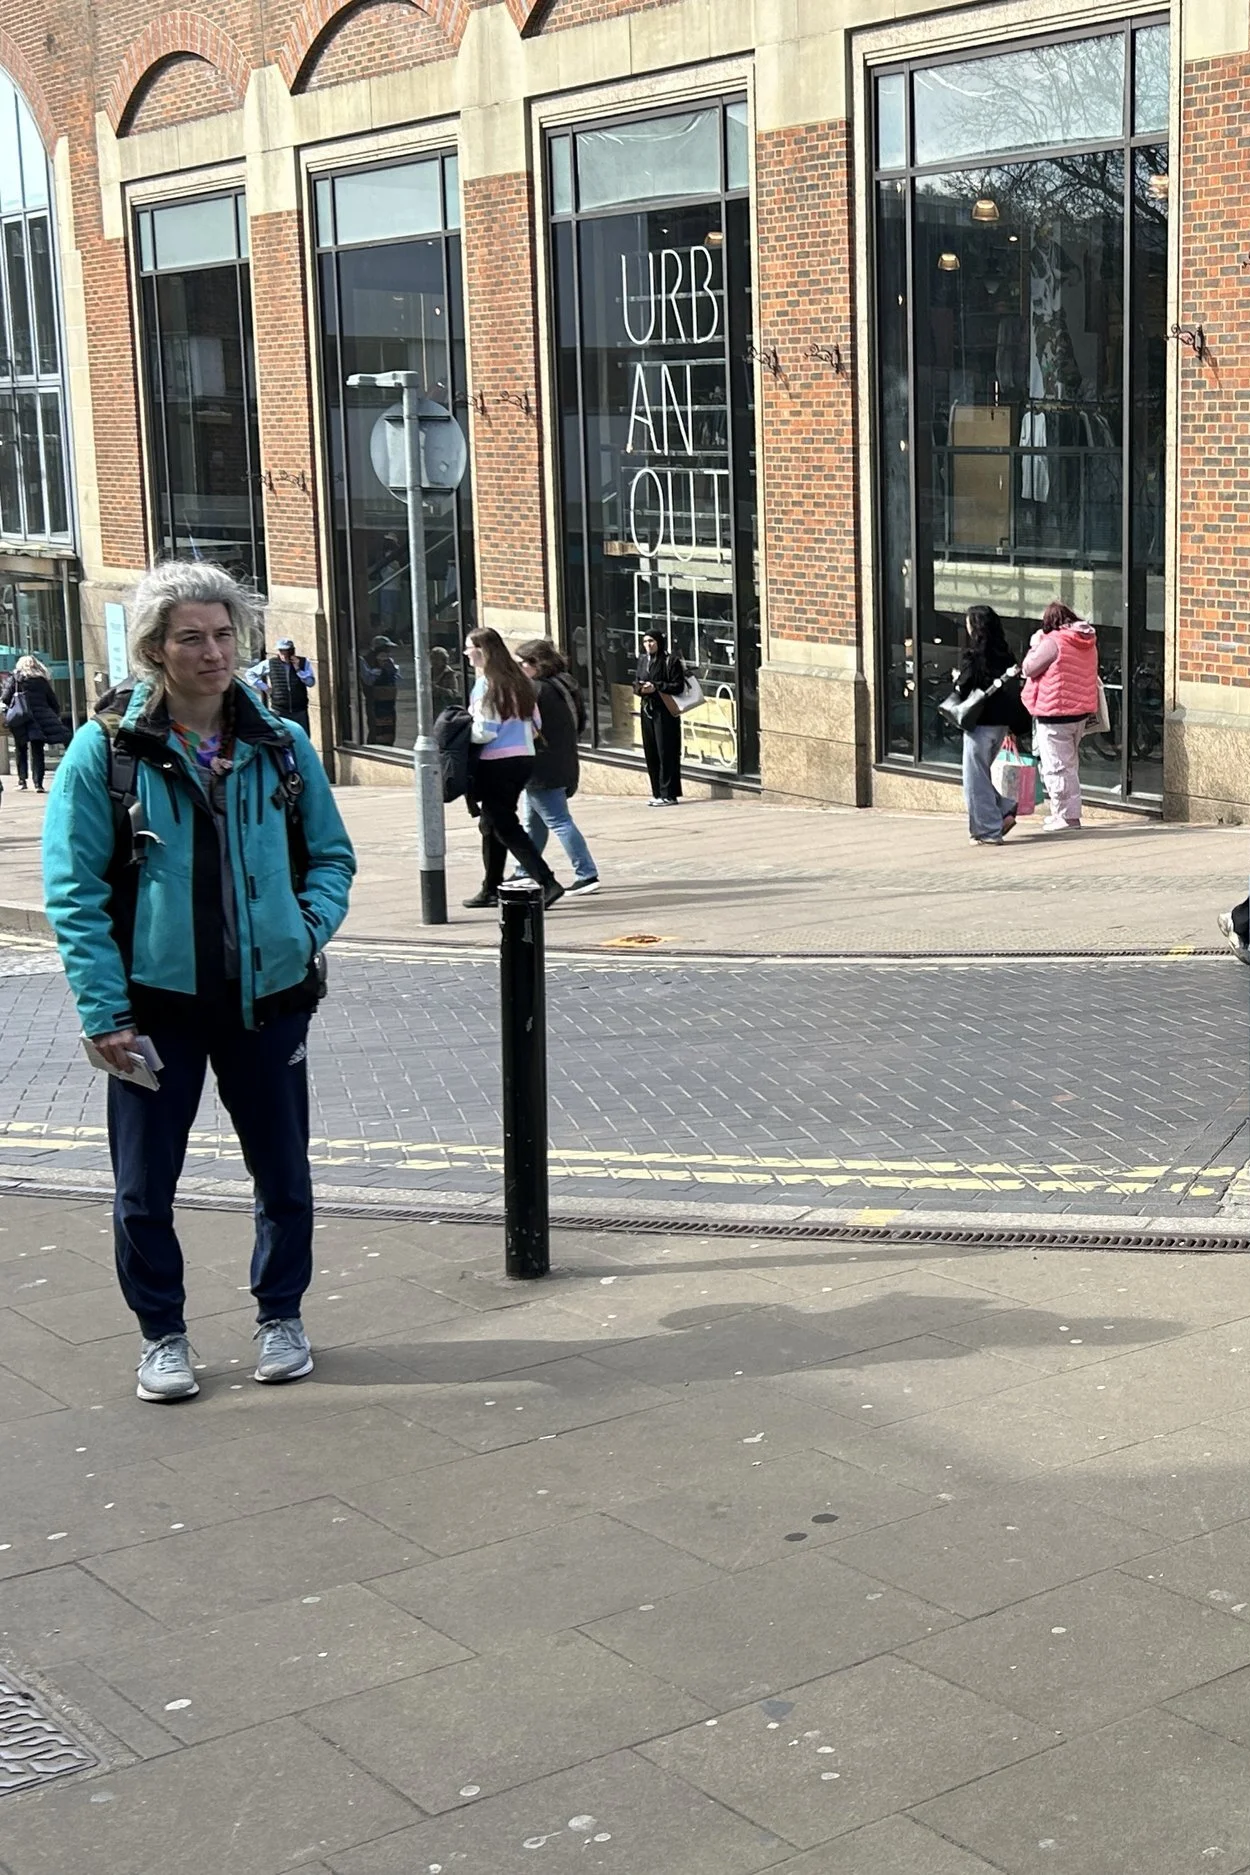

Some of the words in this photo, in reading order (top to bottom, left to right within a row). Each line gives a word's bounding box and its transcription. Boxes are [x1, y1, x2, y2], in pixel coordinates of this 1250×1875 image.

[621, 246, 719, 345] URB
[627, 363, 695, 456] AN
[630, 467, 730, 564] OUT
